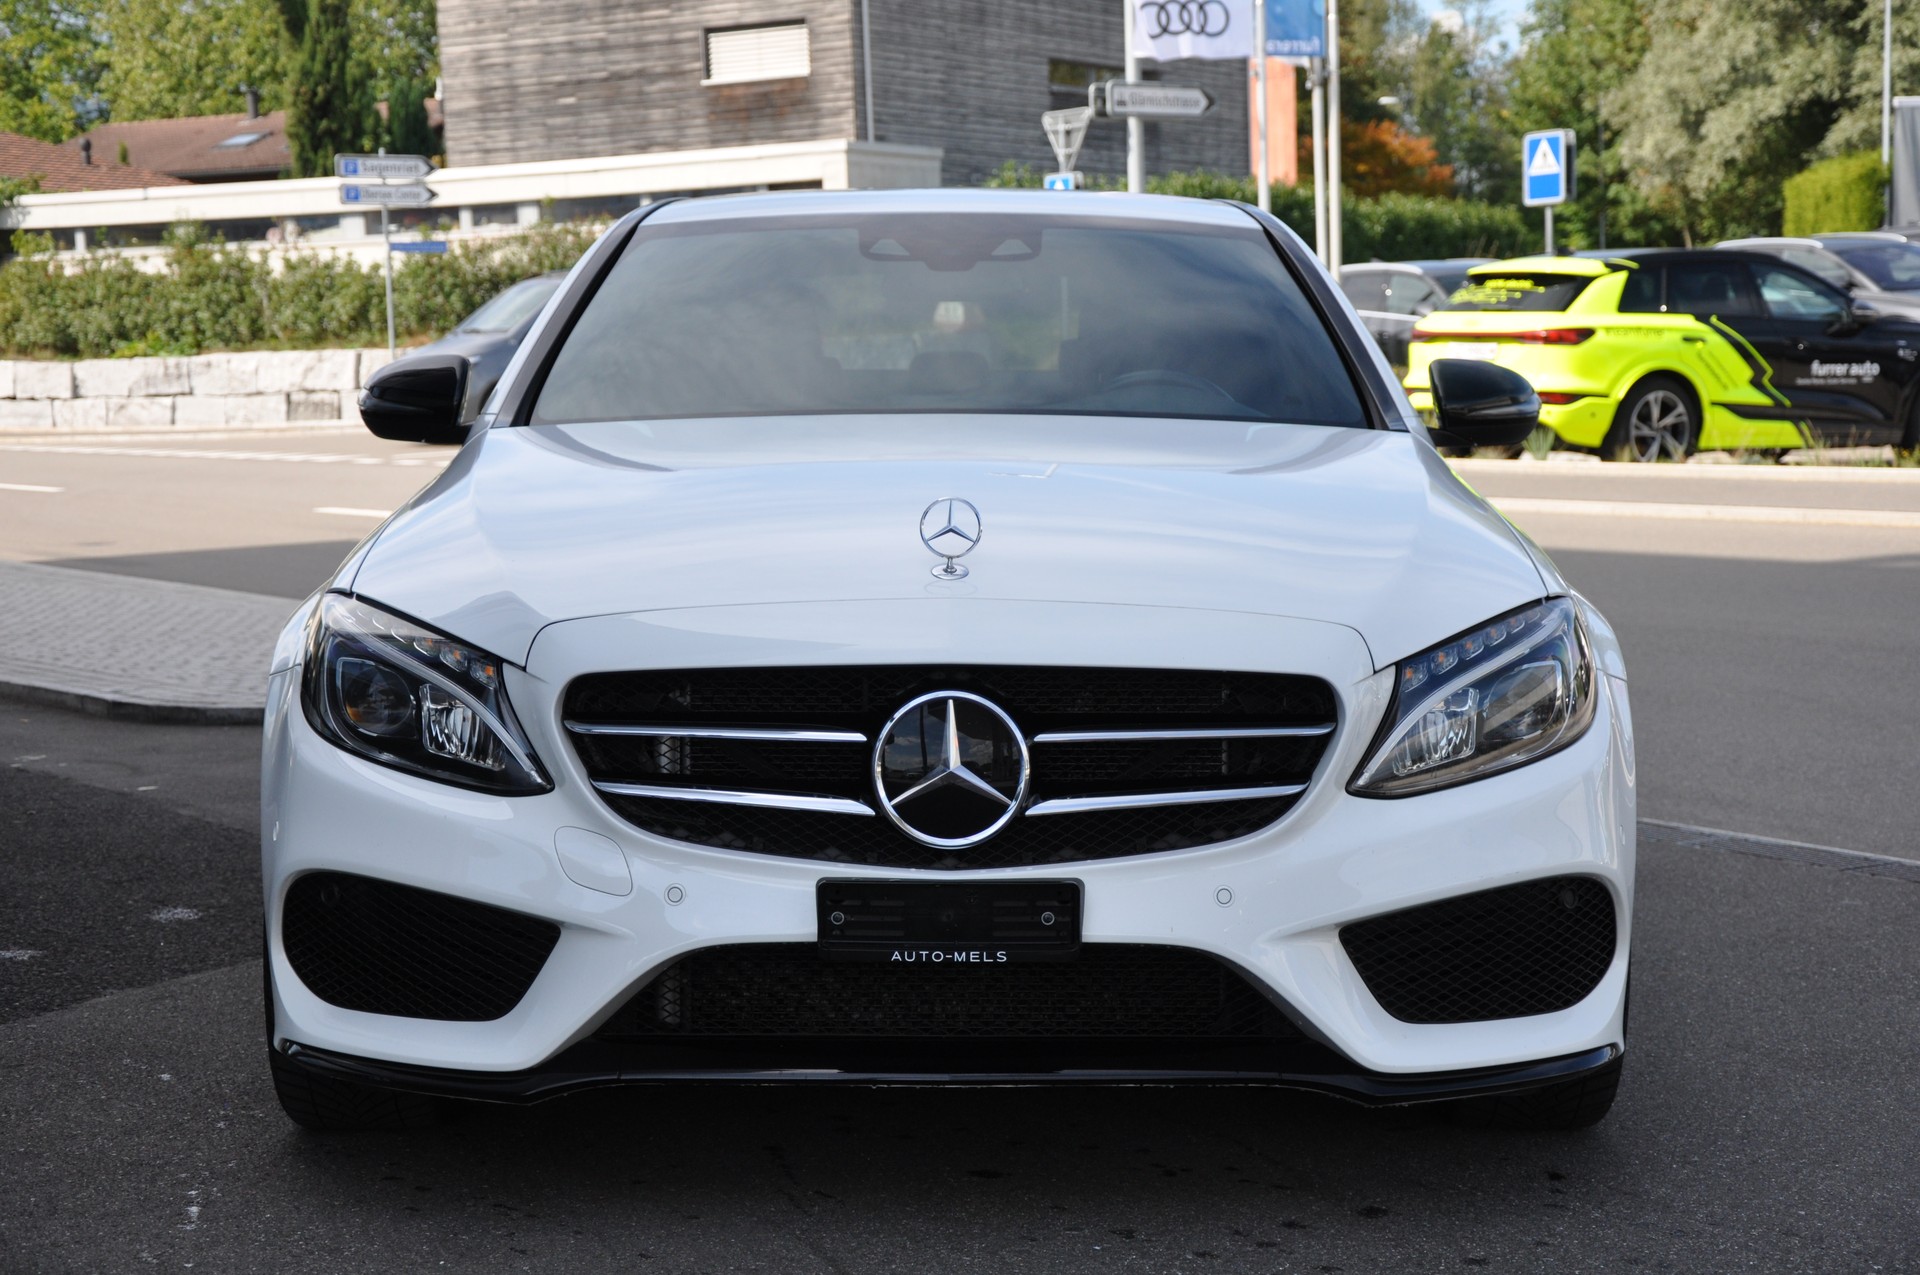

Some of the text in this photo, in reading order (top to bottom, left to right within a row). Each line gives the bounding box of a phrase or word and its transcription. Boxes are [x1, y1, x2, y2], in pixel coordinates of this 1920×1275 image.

[1811, 359, 1880, 376] furrer auto
[891, 951, 1007, 962] AUTO-MELS
